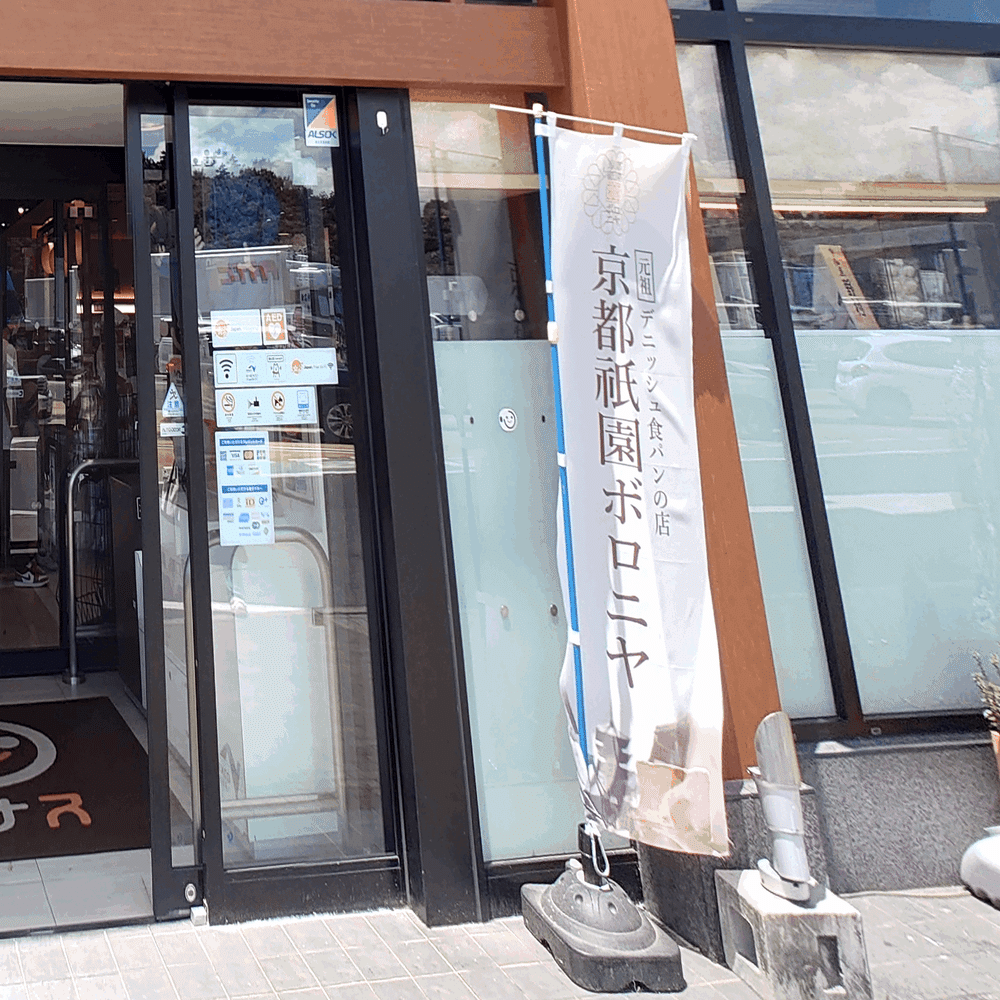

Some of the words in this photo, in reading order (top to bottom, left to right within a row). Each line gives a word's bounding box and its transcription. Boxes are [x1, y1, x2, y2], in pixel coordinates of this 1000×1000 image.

[308, 130, 337, 139] ALSOK
[265, 313, 283, 321] AED
[591, 244, 649, 689] 京都祇園ボロニヤ
[640, 308, 670, 537] デニッシュ食パンの店
